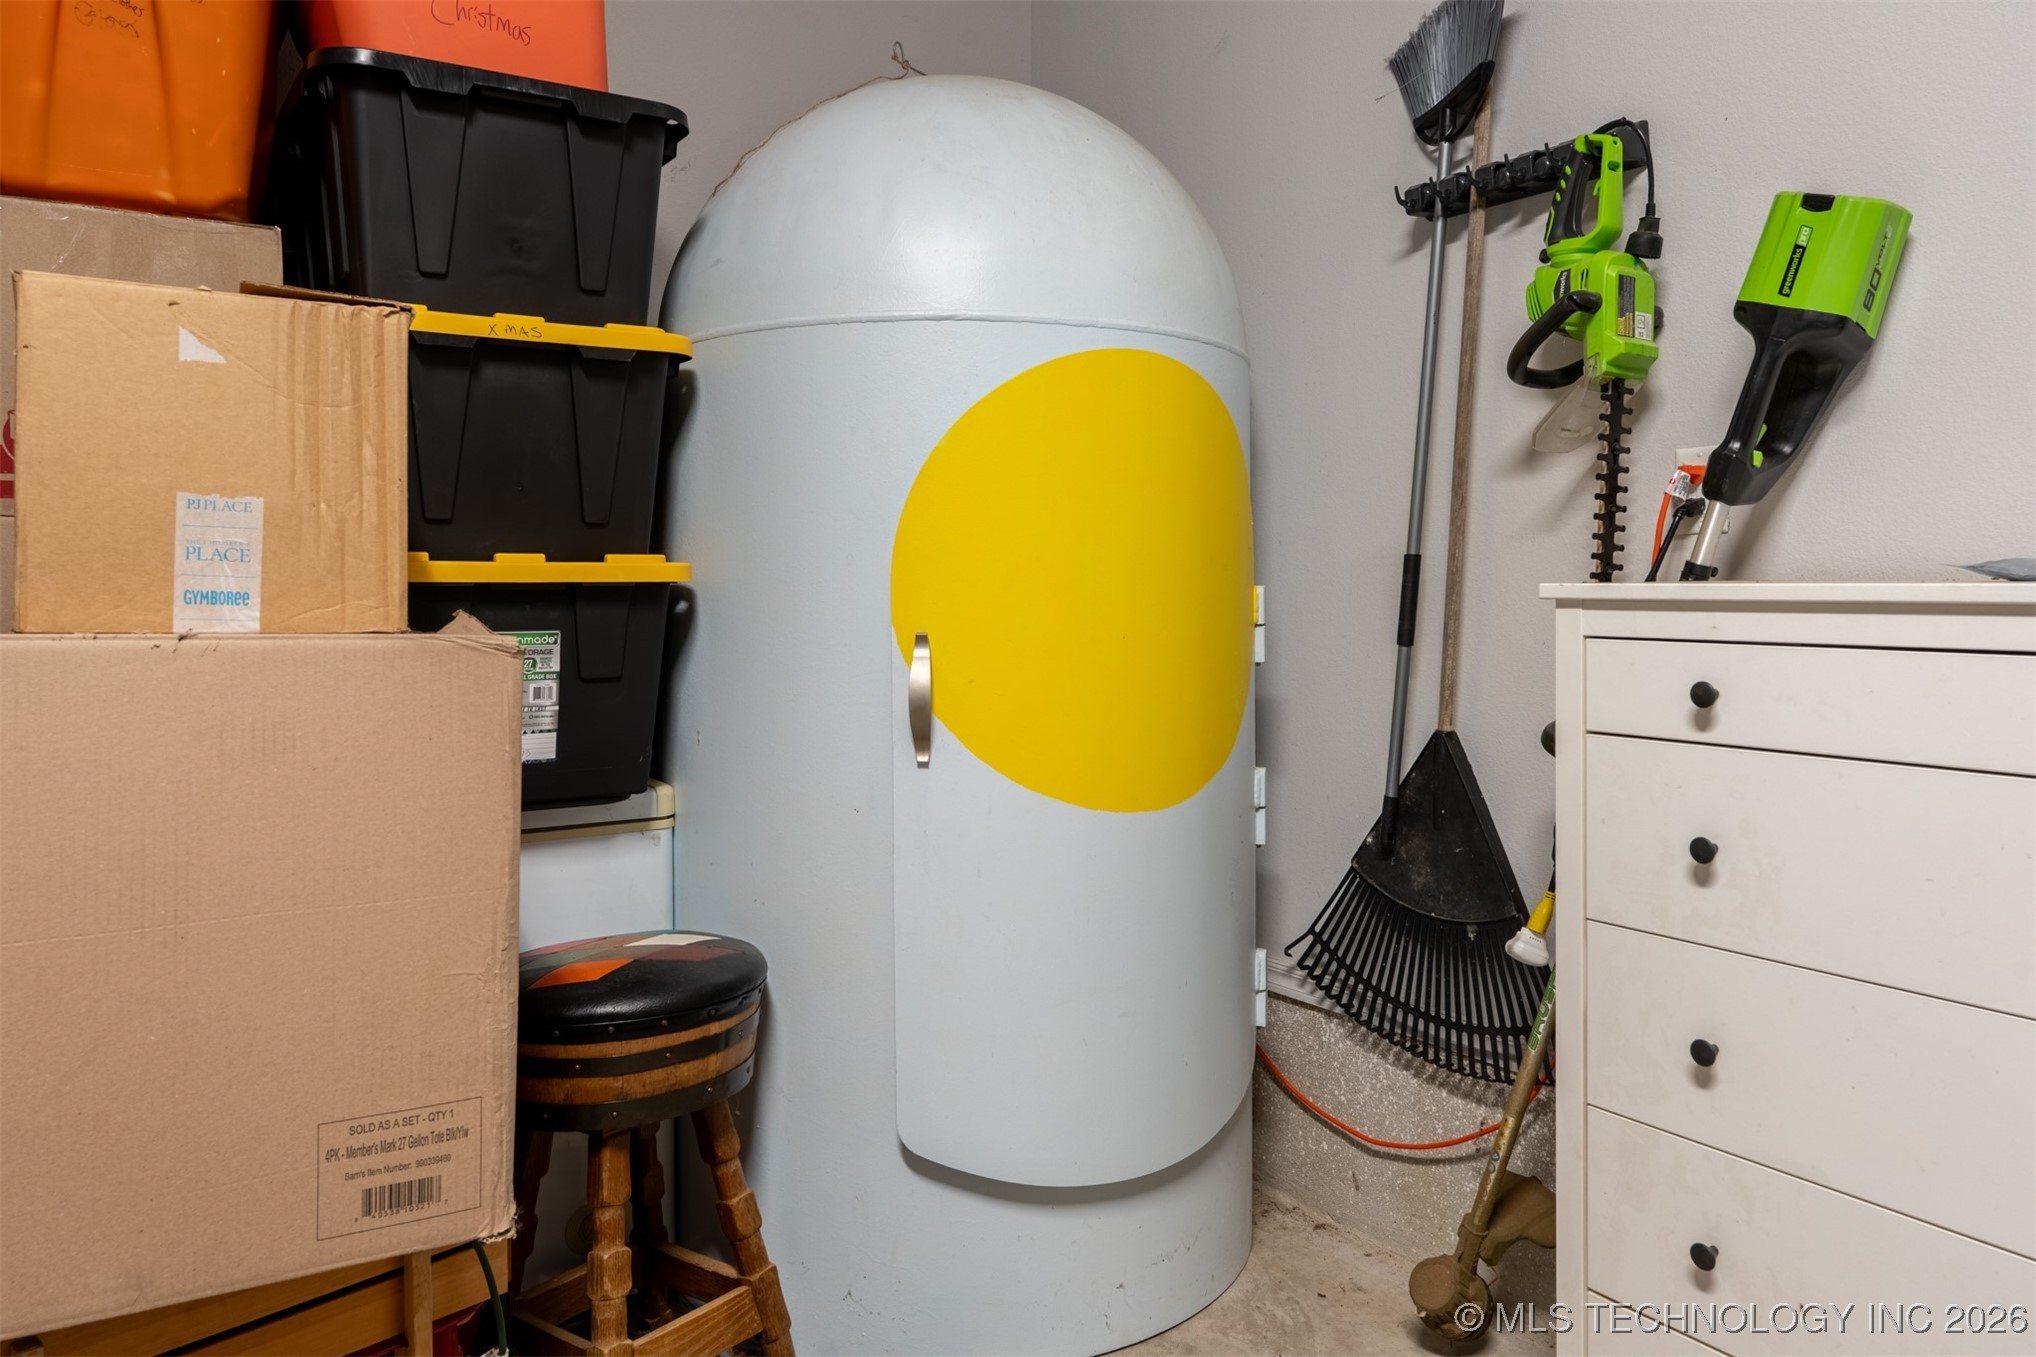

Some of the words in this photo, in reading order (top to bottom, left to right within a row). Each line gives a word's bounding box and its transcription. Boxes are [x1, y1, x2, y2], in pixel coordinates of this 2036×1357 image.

[1782, 248, 1804, 295] greenworks
[1863, 267, 1882, 312] 80
[185, 545, 251, 563] PLACE
[518, 634, 556, 645] nmade
[527, 648, 554, 656] ORAGE
[524, 659, 534, 668] 27
[1527, 960, 1556, 1051] BRUS
[349, 1122, 376, 1136] SOLD
[378, 1119, 391, 1131] AS
[393, 1118, 400, 1128] A
[402, 1114, 420, 1127] SET
[428, 1110, 447, 1122] QTY
[325, 1147, 341, 1162] 4PK
[346, 1142, 379, 1159] Member's
[380, 1138, 397, 1154] Mark
[398, 1136, 407, 1150] 27
[408, 1133, 429, 1149] Gallon
[430, 1130, 445, 1144] Tote
[344, 1170, 366, 1181] Sam's
[367, 1167, 383, 1177] Item
